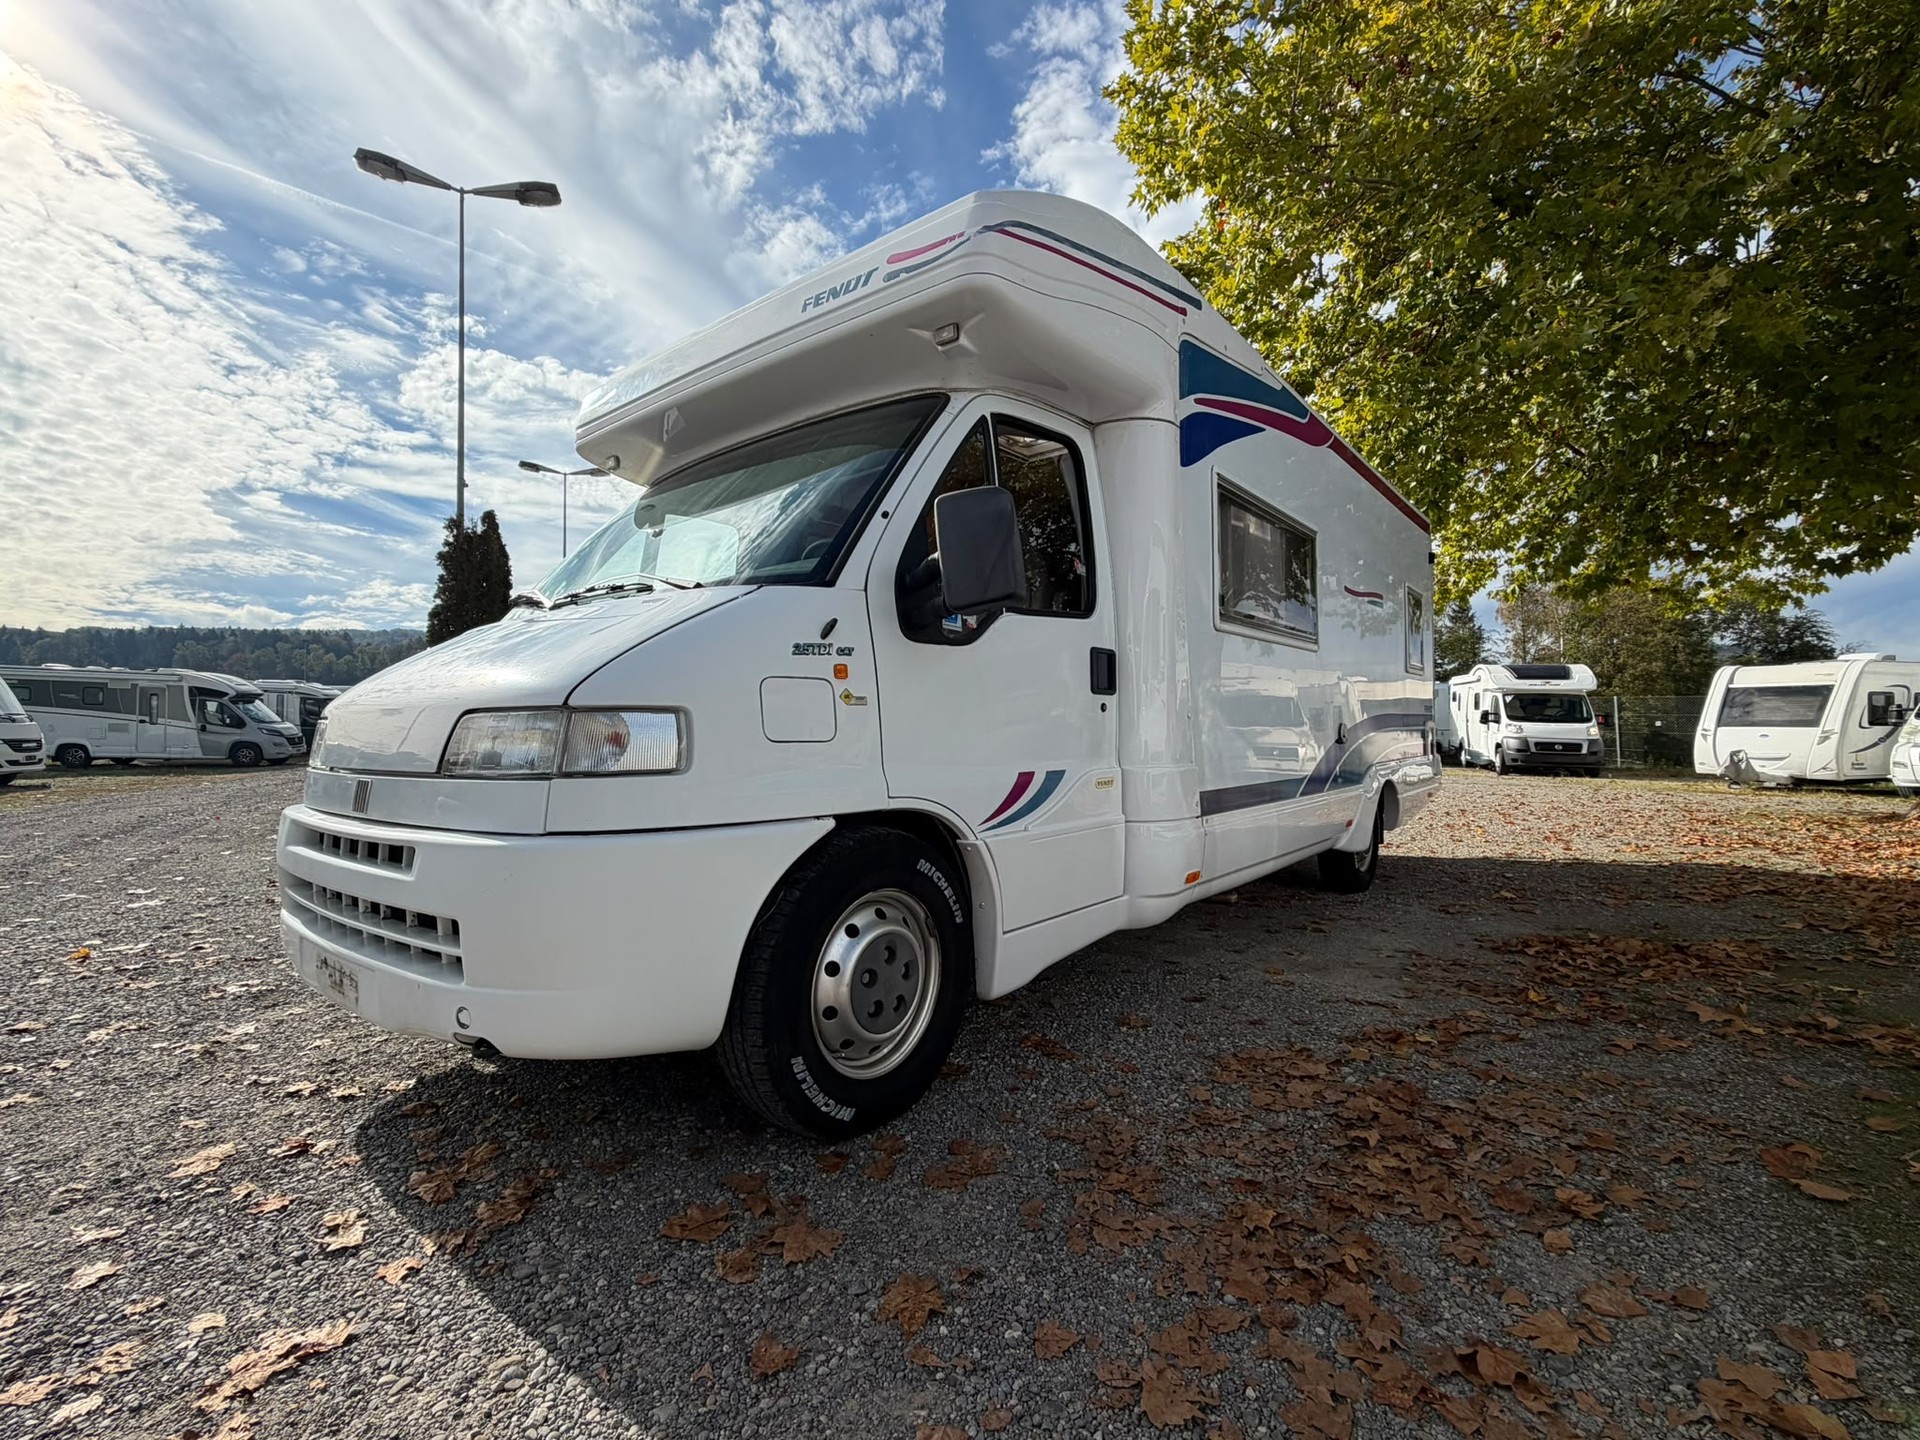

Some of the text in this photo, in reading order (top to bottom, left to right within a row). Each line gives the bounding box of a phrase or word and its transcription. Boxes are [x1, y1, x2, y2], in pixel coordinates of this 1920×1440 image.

[801, 266, 879, 313] FENDT
[917, 858, 963, 923] MICHELIN
[790, 1056, 856, 1121] MICHELIN
